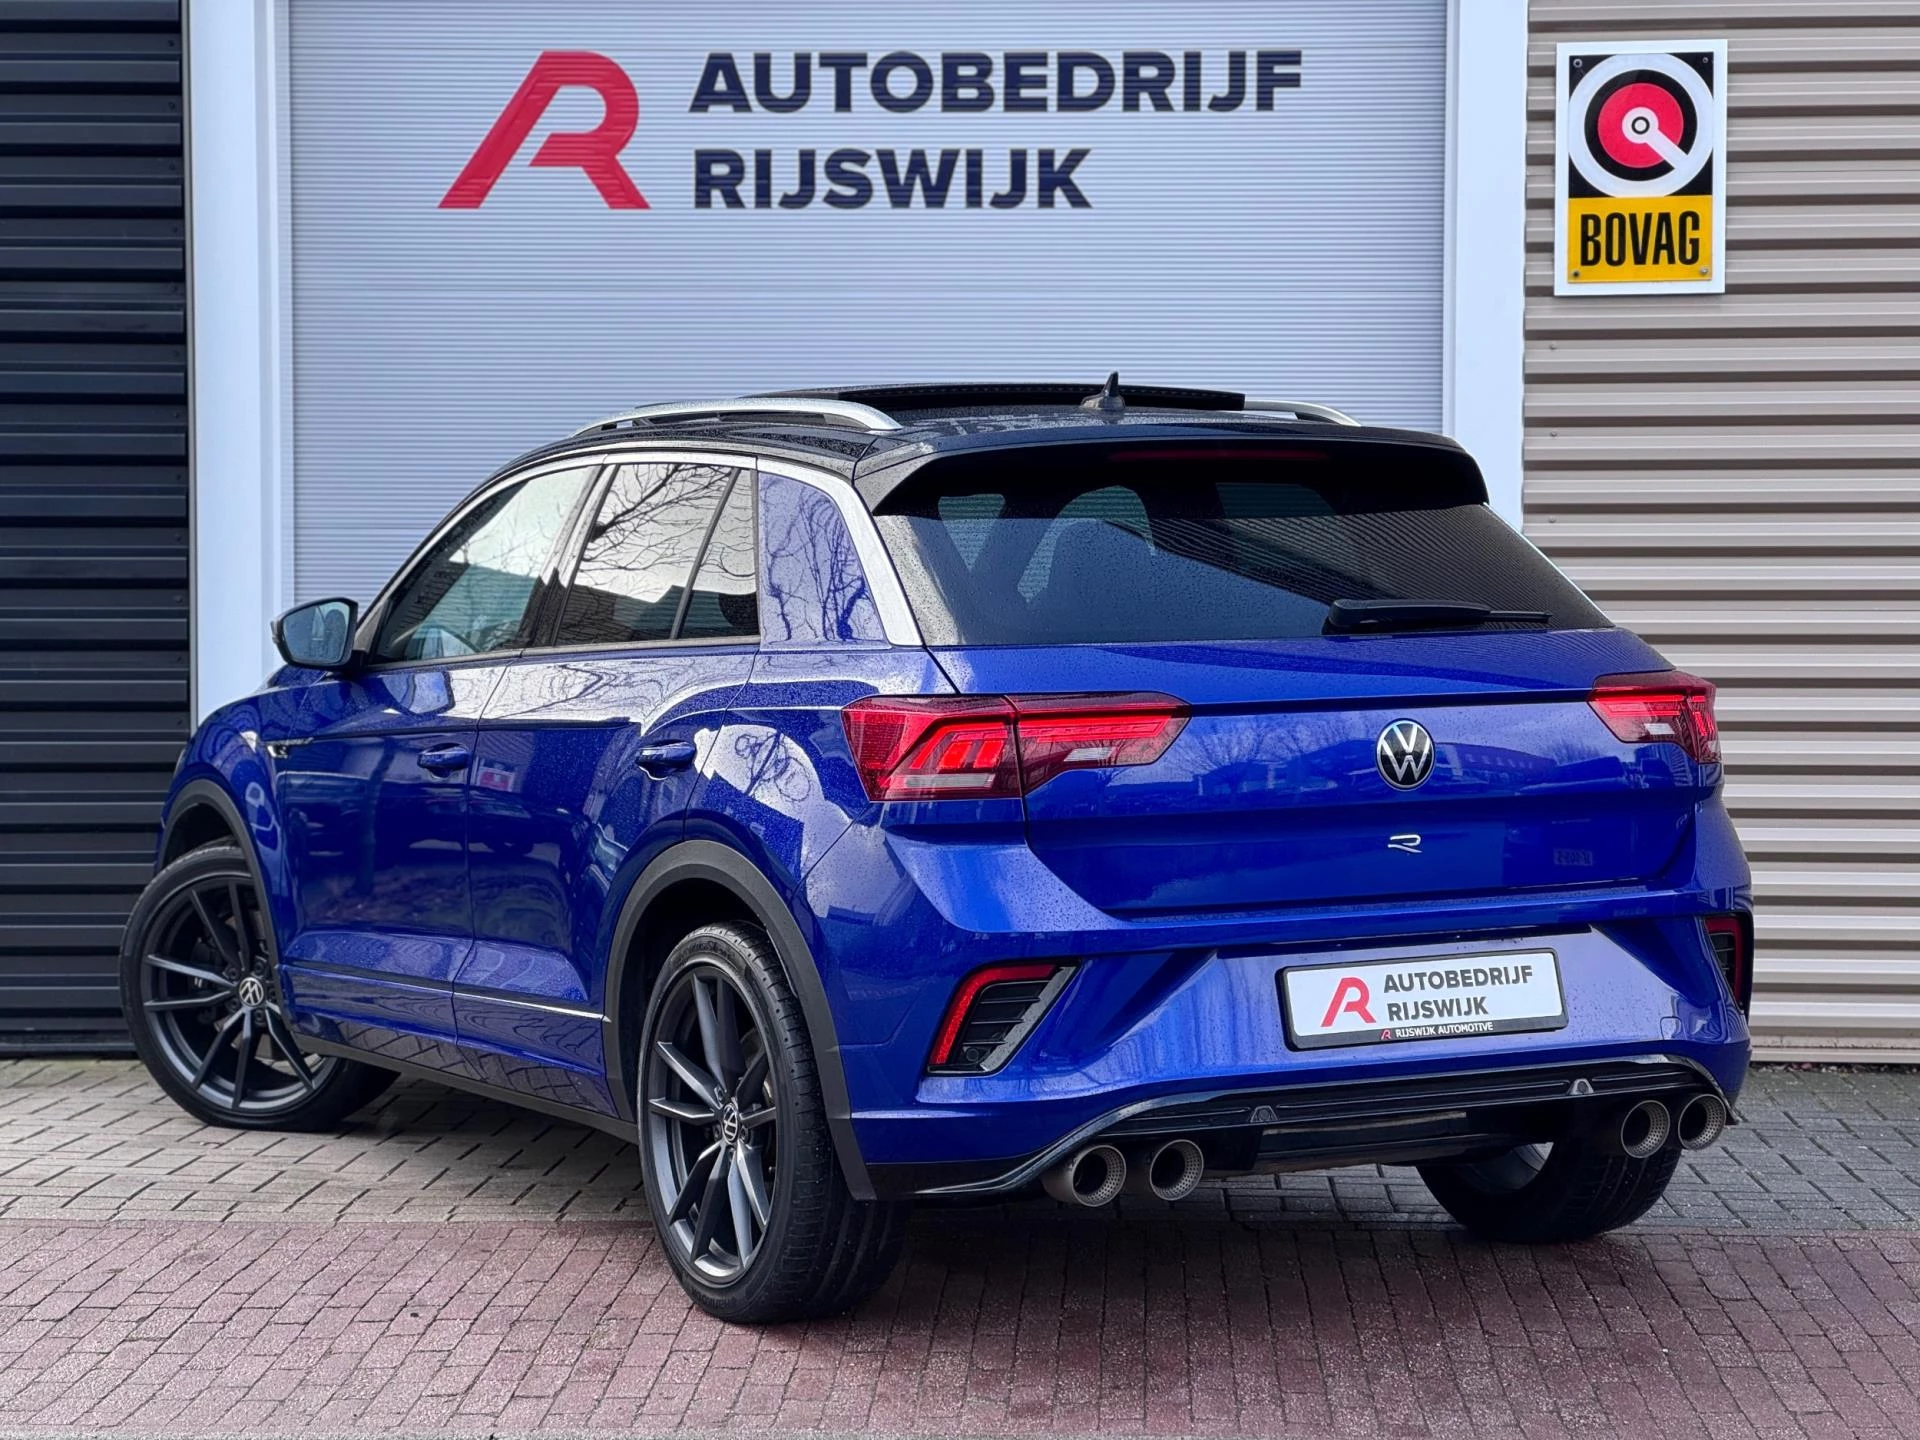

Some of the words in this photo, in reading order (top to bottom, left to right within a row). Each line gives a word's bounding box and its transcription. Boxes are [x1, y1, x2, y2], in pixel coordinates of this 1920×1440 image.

[690, 51, 1302, 113] AUTOBEDRIJF
[694, 149, 1092, 209] RIJSWIJK
[1580, 210, 1700, 267] BOVAG
[1383, 965, 1533, 993] AUTOBEDRIJF
[1387, 996, 1489, 1021] RIJSWIJK
[1395, 1026, 1437, 1038] RIJSWIJK
[1438, 1021, 1494, 1035] AUTOMOTIVE
